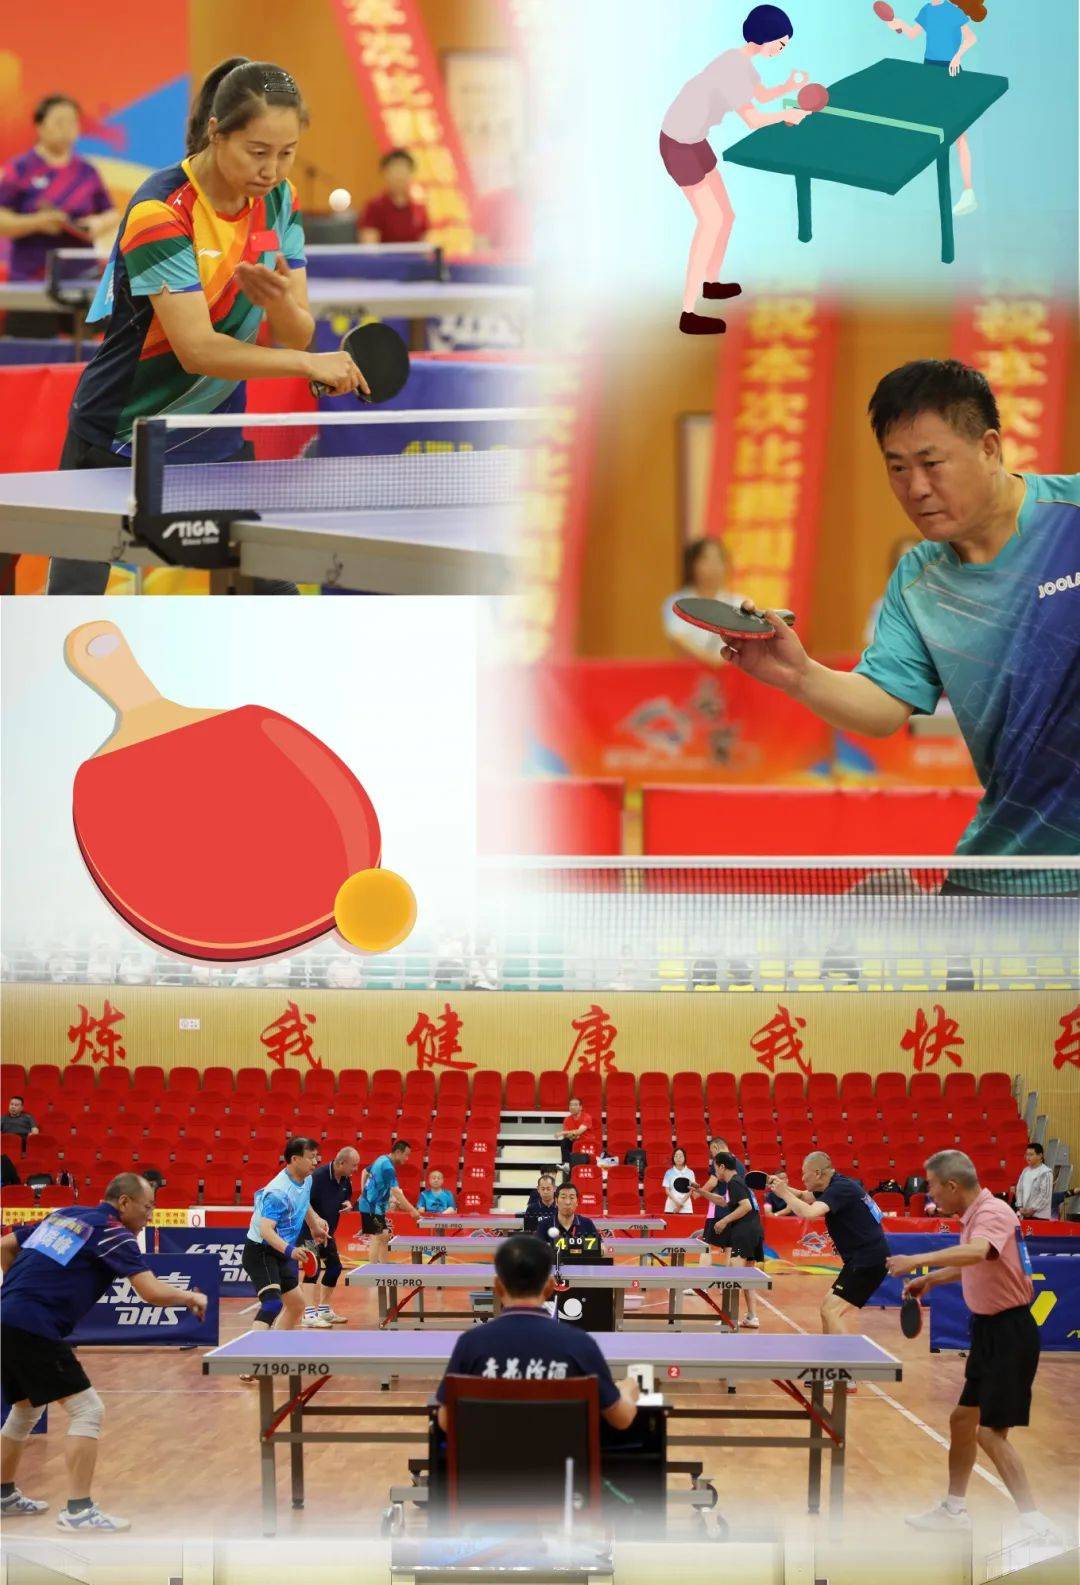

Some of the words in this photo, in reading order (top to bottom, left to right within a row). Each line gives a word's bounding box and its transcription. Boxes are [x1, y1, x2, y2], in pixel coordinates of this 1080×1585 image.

[162, 520, 220, 540] STIGA
[68, 999, 127, 1067] 炼
[584, 1238, 597, 1250] 7
[221, 1268, 252, 1282] DH
[375, 1278, 423, 1287] 7190-PRO
[708, 1280, 742, 1289] STIGA
[115, 1306, 187, 1326] DHS
[252, 1362, 331, 1376] 7190-PRO
[798, 1368, 852, 1380] STIGA
